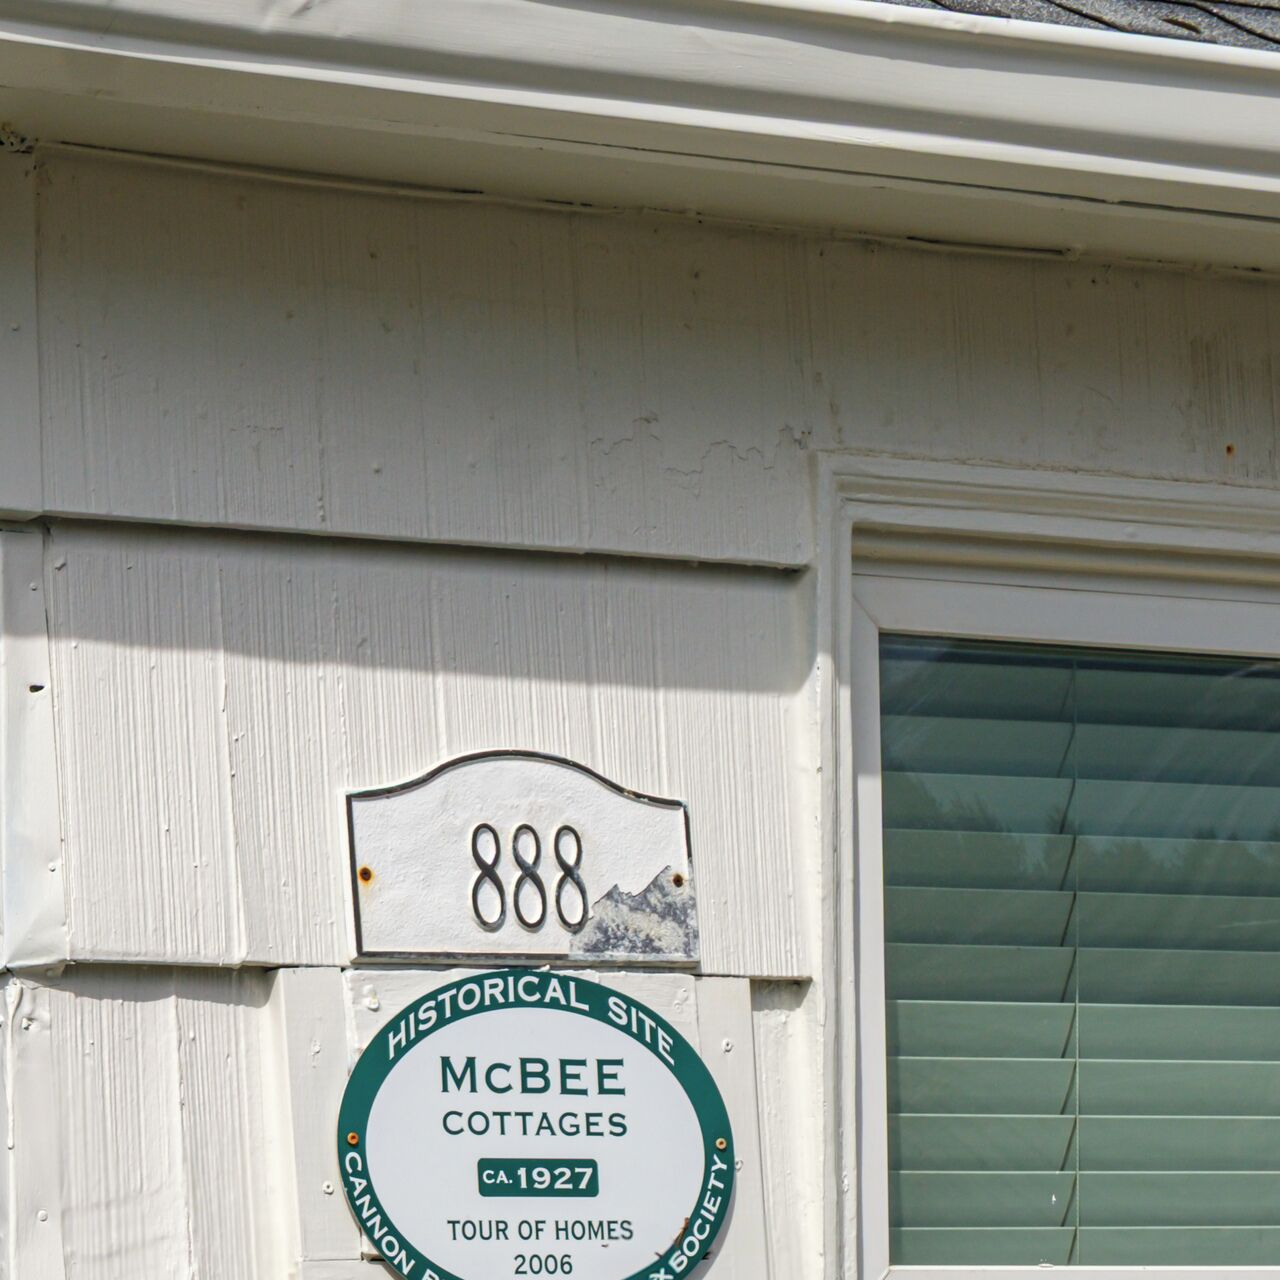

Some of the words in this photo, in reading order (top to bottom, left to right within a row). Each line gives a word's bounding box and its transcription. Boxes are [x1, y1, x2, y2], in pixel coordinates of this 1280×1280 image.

[471, 822, 590, 932] 888
[387, 975, 590, 1061] HISTORICAL
[607, 996, 675, 1067] SITE
[440, 1056, 627, 1097] McBEE
[442, 1111, 628, 1138] COTTAGES
[482, 1169, 513, 1185] CA.
[517, 1166, 594, 1191] 1927
[344, 1151, 416, 1276] CANNON
[447, 1219, 510, 1242] TOUR
[517, 1220, 549, 1241] OF
[554, 1220, 635, 1242] HOMES
[513, 1253, 574, 1276] 2006
